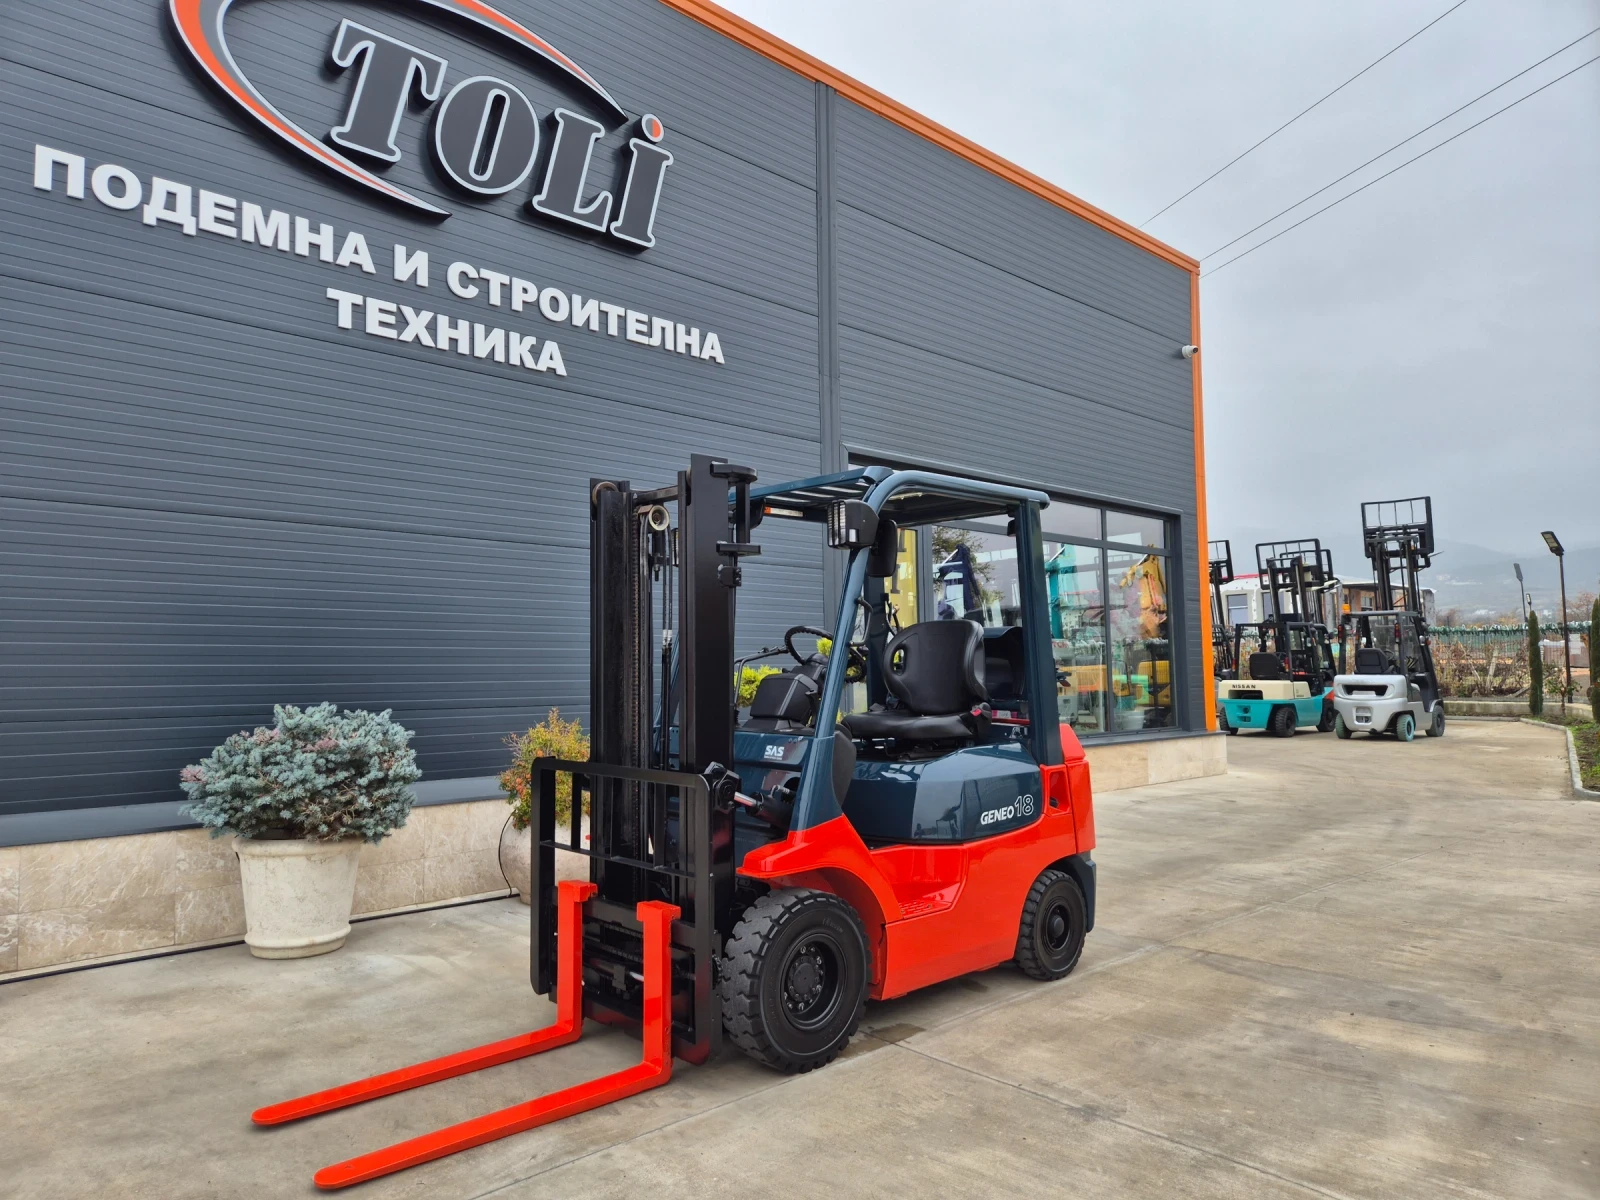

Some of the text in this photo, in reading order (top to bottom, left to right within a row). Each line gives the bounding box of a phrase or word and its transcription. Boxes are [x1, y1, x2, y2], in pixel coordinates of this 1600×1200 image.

[33, 143, 726, 365] ПОДЕМНА И СТРОИТЕЛНА
[326, 287, 568, 377] ТЕХНИКА
[764, 744, 785, 757] SAS
[980, 794, 1034, 825] GENEO 18
